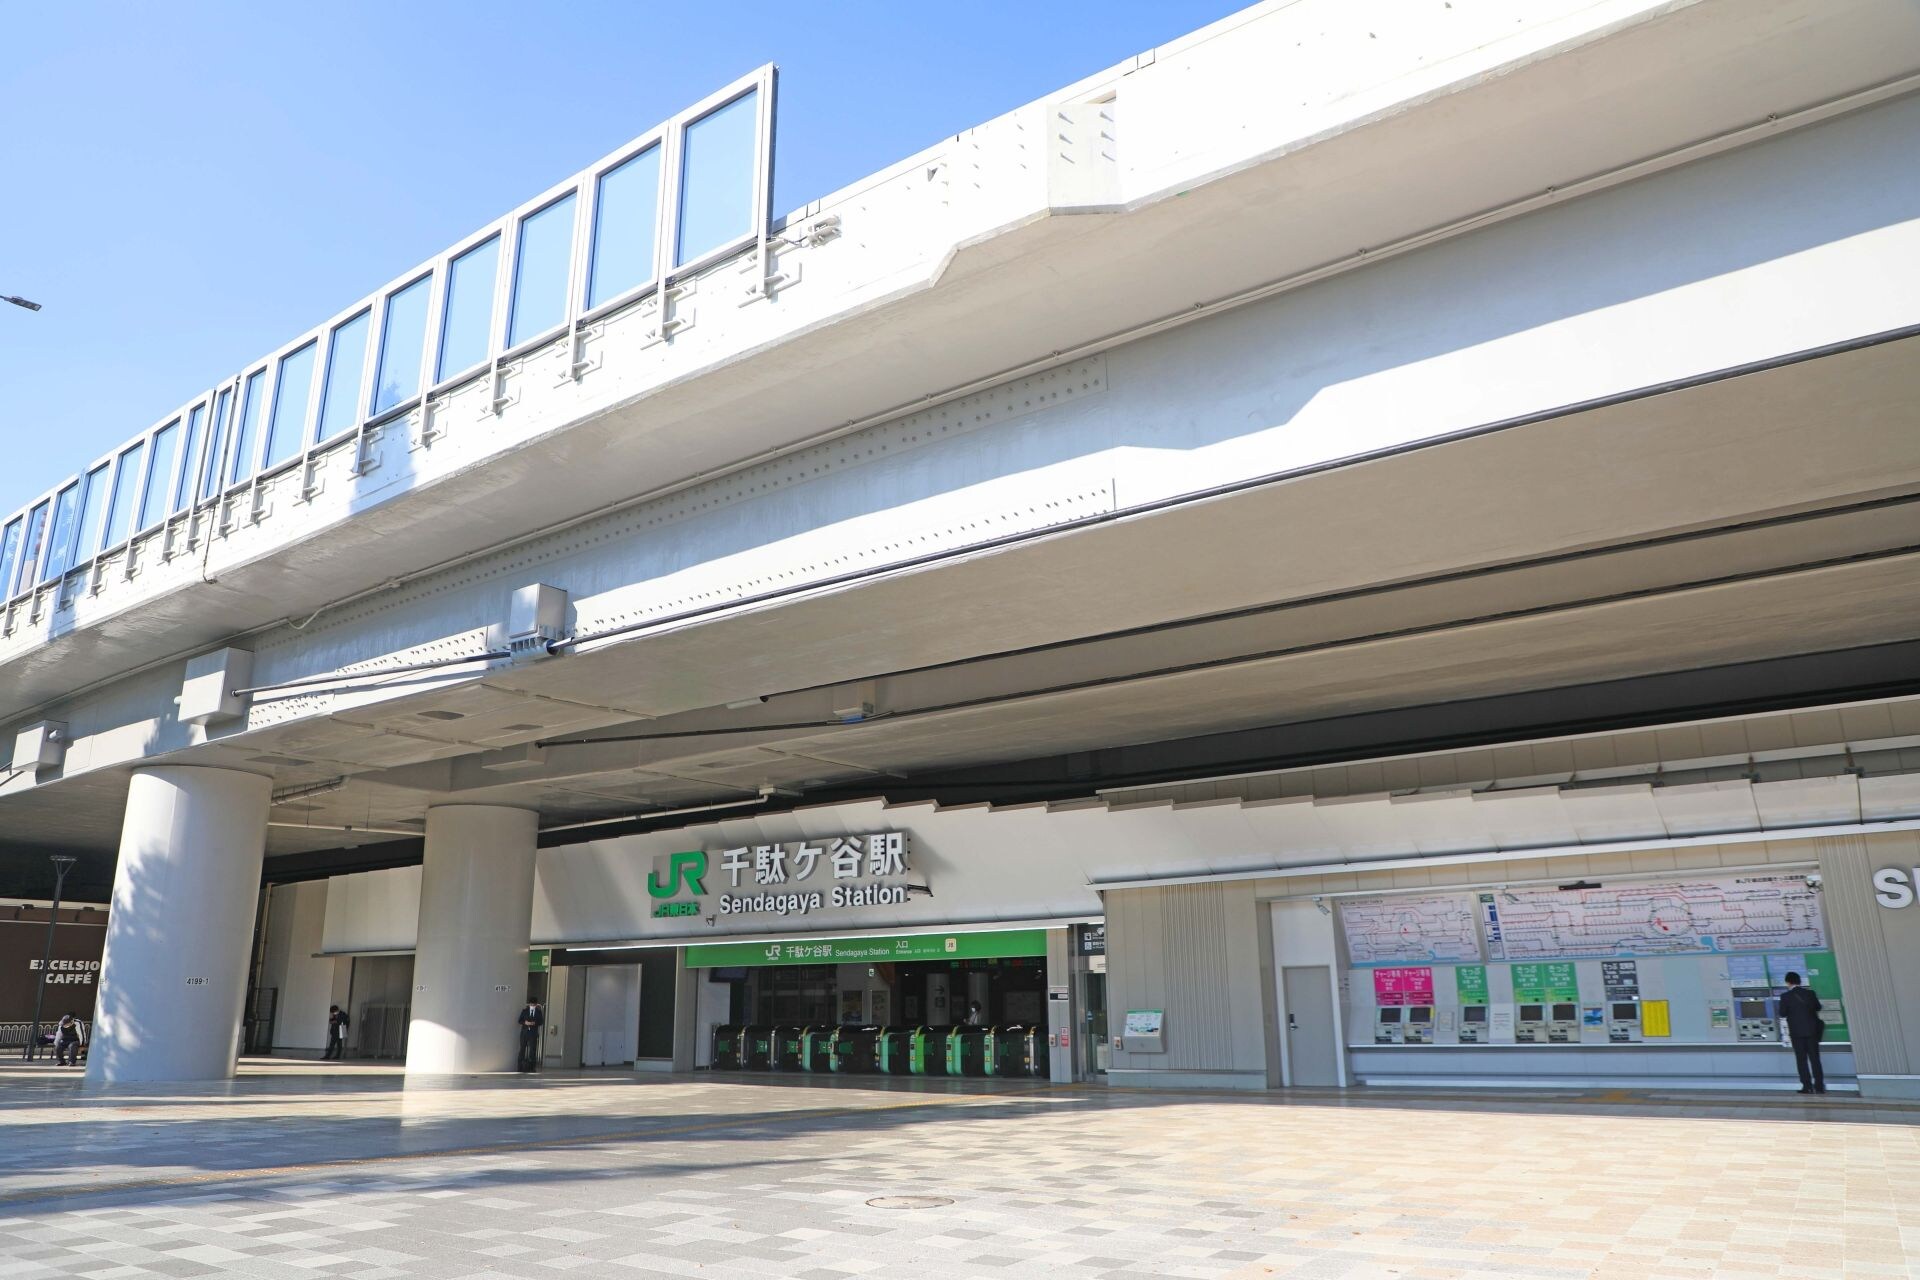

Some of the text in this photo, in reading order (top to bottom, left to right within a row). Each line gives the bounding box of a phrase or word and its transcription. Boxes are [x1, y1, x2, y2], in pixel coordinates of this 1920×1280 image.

[648, 850, 707, 899] JR
[1873, 867, 1920, 909] S
[720, 884, 904, 916] Sendagaya Station
[765, 945, 781, 957] JR
[835, 947, 890, 958] Sendagaya Station
[45, 972, 92, 984] CAFFÉ
